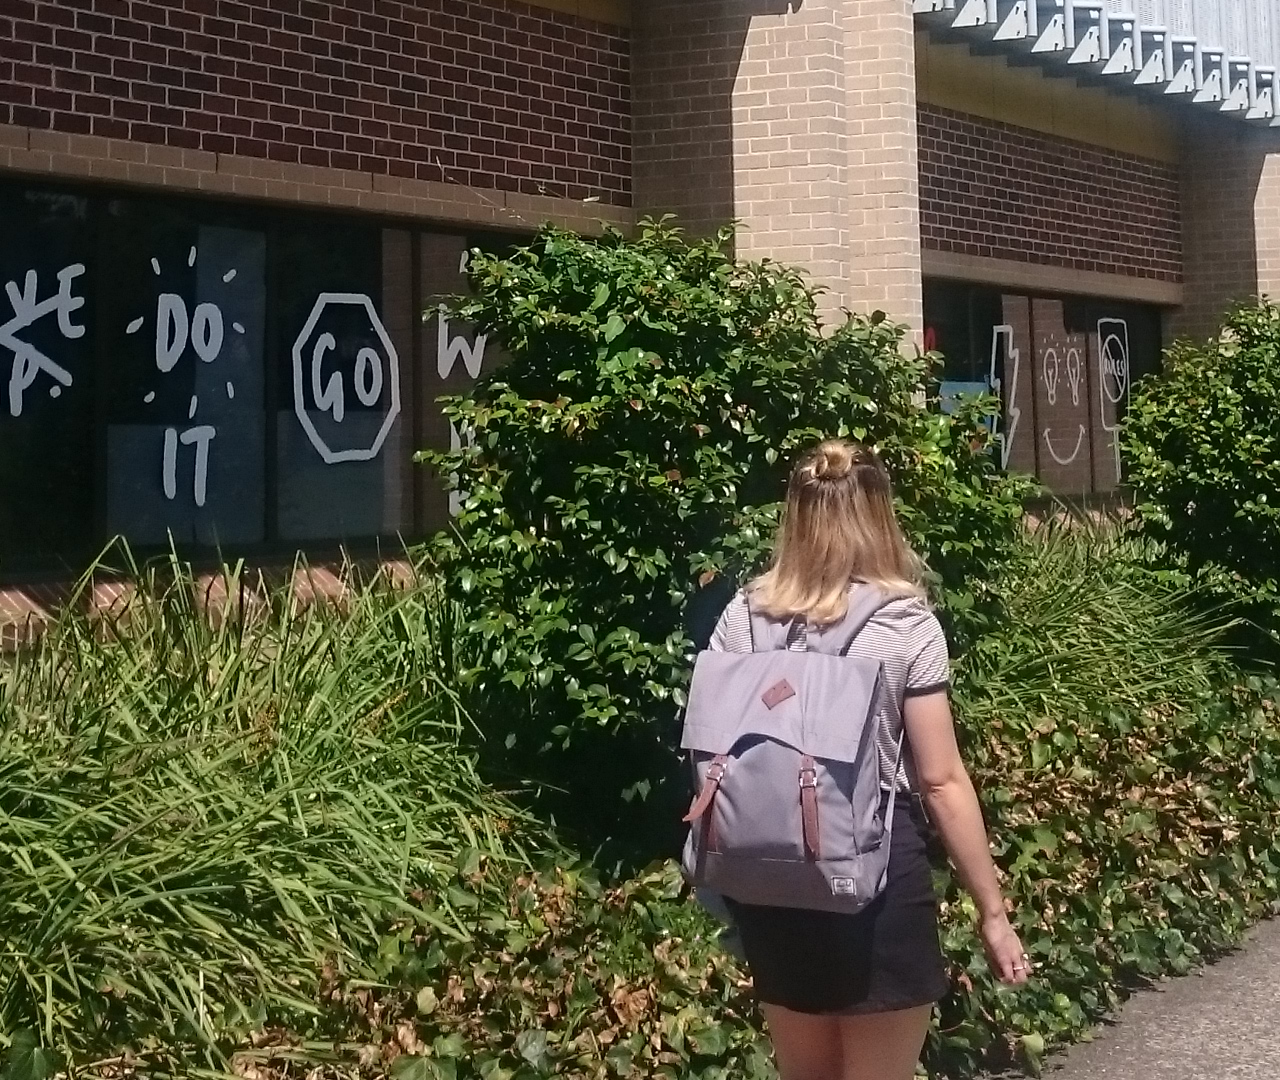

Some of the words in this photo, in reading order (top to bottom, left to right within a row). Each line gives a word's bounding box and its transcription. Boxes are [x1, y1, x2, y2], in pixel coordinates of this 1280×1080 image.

[156, 292, 224, 372] DO
[312, 332, 383, 422] GO
[162, 425, 217, 507] IT
